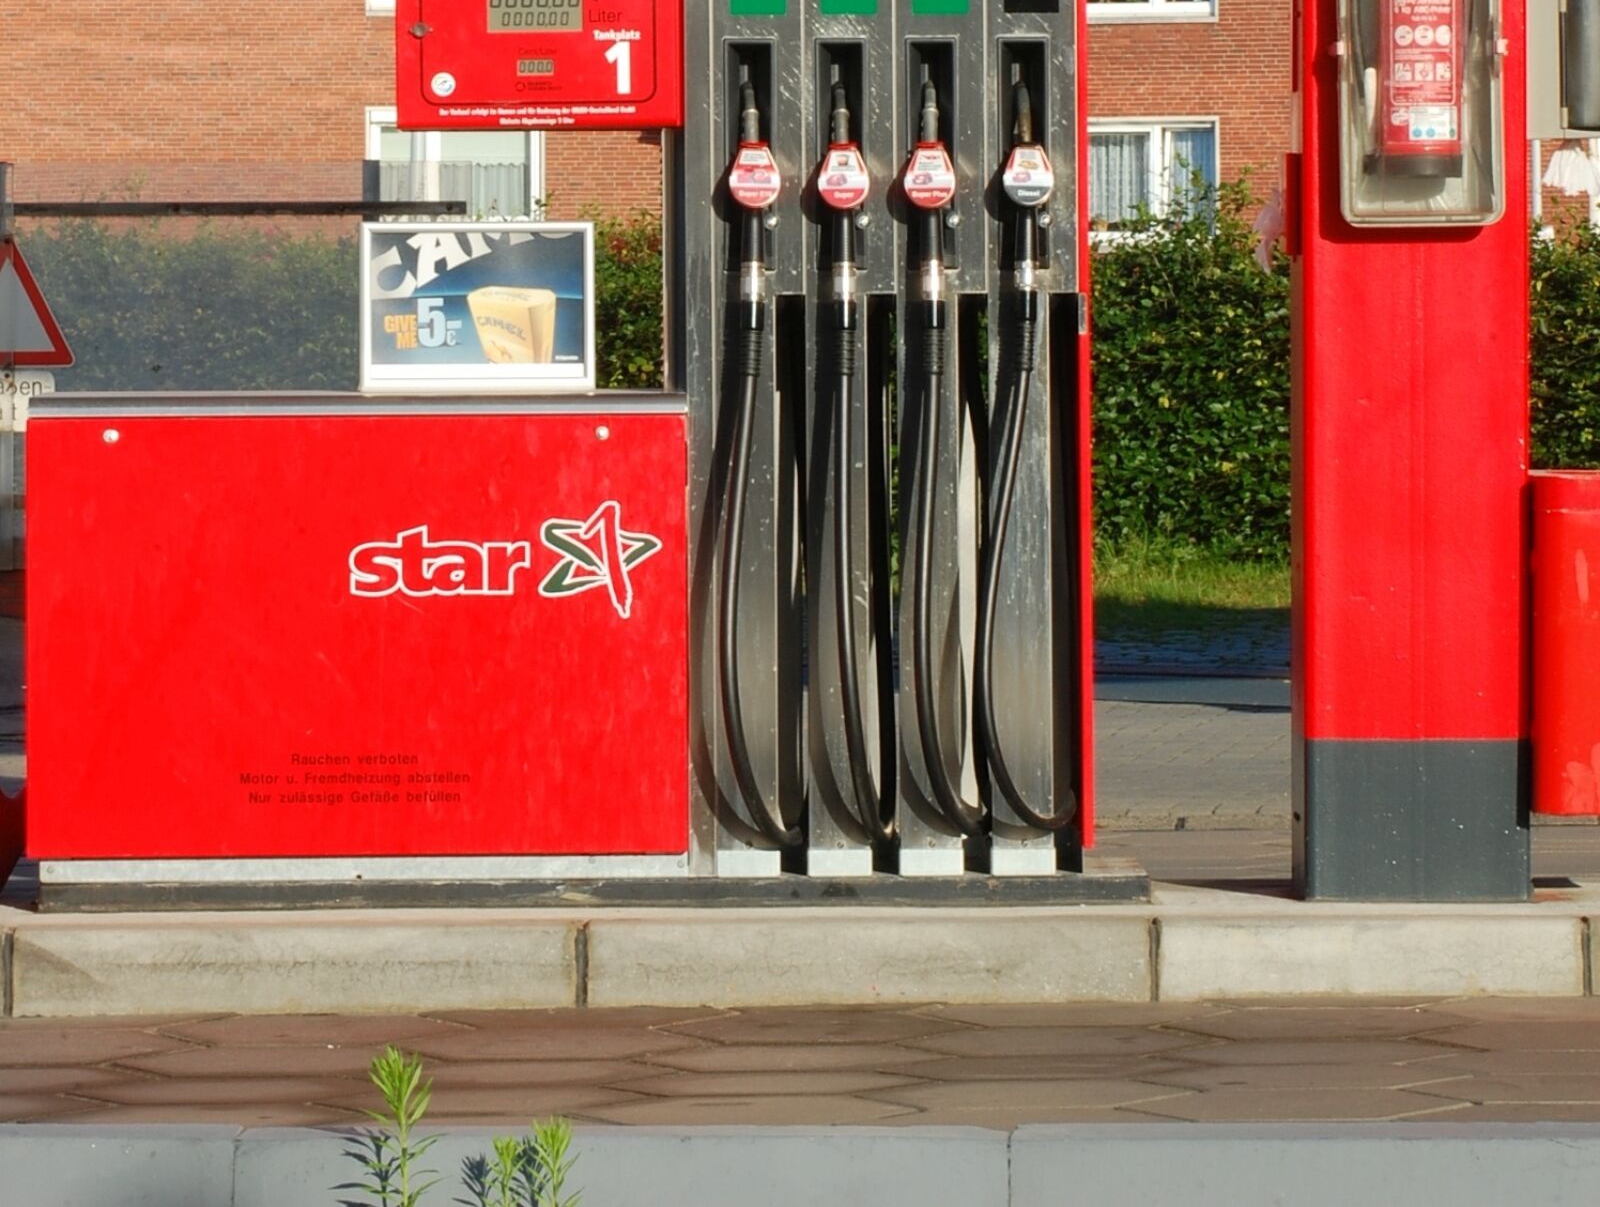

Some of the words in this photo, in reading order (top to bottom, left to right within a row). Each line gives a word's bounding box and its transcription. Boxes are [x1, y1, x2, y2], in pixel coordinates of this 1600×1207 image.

[588, 9, 622, 23] Liter
[593, 29, 641, 42] Tankplatz
[604, 41, 632, 95] 1
[1017, 189, 1040, 197] Diesel
[384, 314, 417, 333] GIVE
[395, 332, 417, 349] ME
[349, 525, 531, 596] star
[291, 754, 350, 765] Rauchen
[357, 754, 418, 765] verboten
[240, 773, 279, 784] Motor
[286, 775, 298, 784] u.
[304, 772, 401, 786] Fremdheizung
[407, 772, 470, 783] abstellen
[248, 792, 272, 803] Nur
[279, 791, 343, 805] zulässige
[406, 791, 461, 802] befüllen
